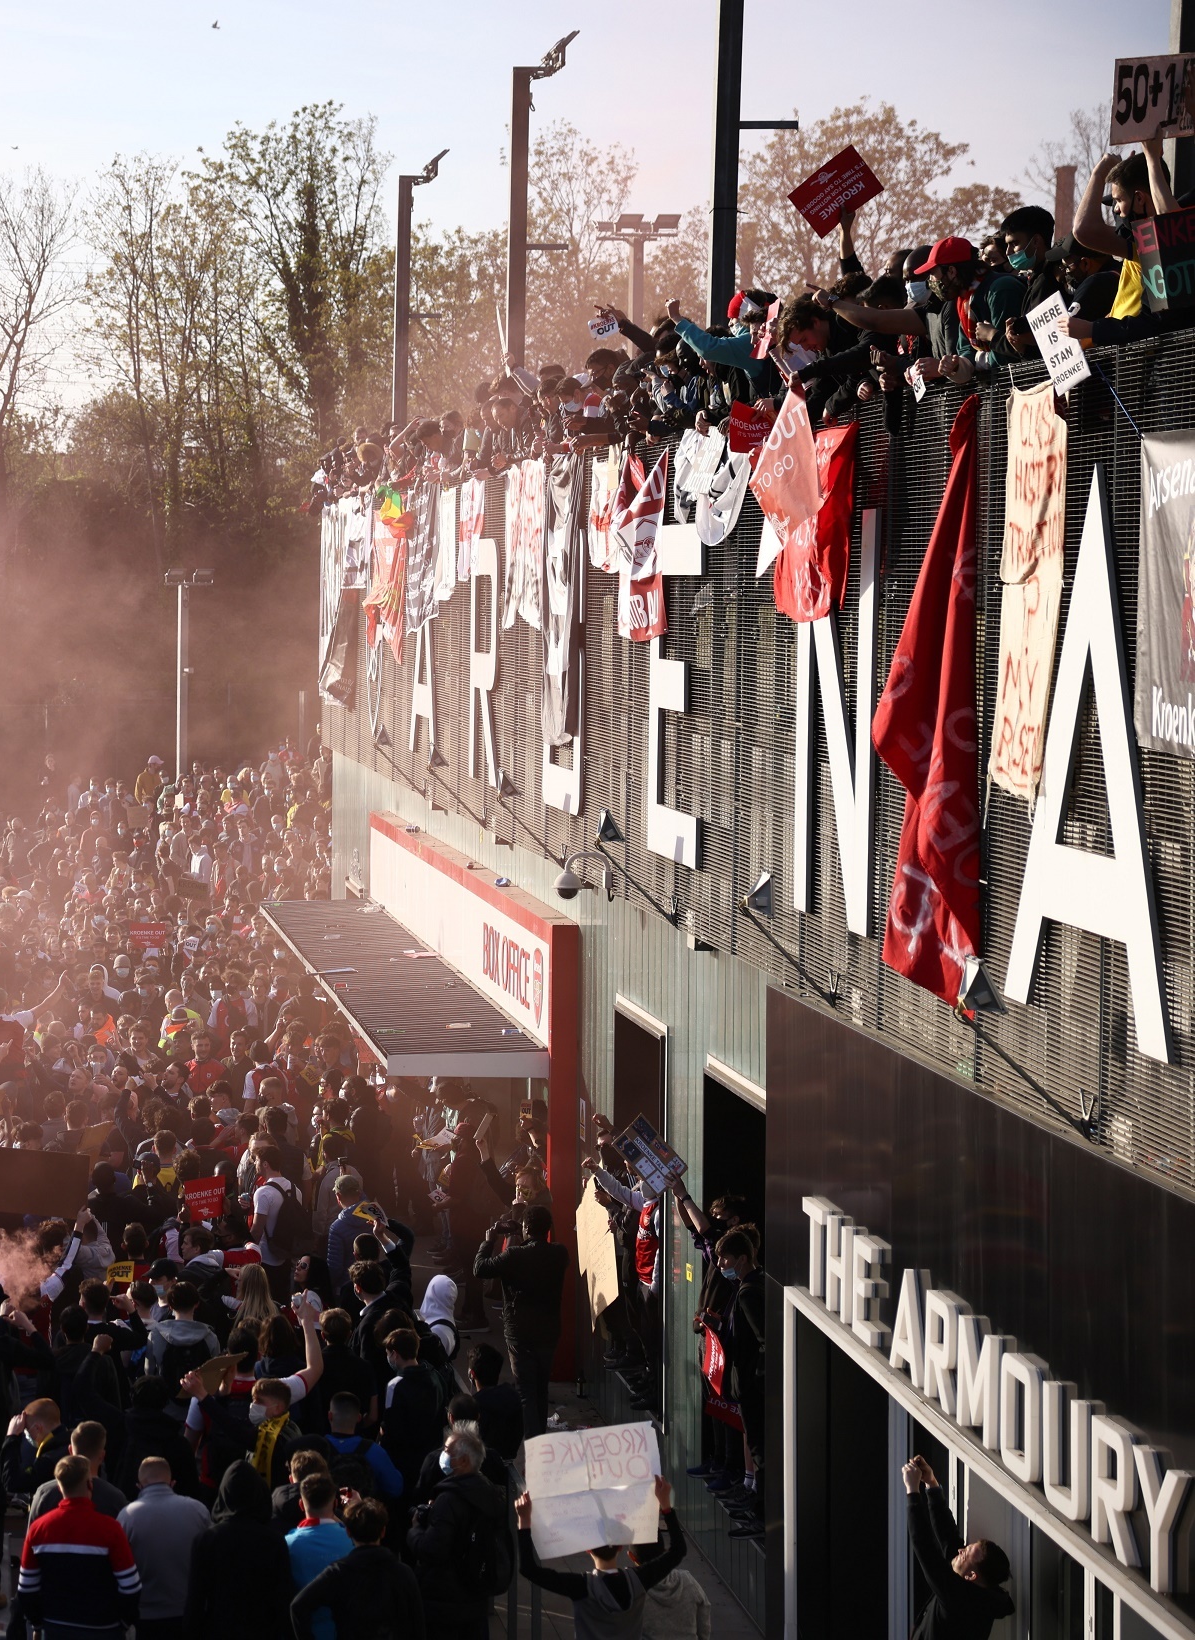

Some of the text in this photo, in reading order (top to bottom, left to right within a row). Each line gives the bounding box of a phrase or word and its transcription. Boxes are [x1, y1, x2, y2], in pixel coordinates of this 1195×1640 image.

[1115, 63, 1177, 127] 50+1
[810, 171, 864, 215] THANKS FOR NOTHING
[818, 181, 866, 221] KROENKE
[597, 322, 616, 335] OUT
[1030, 304, 1063, 332] WHERE
[1048, 331, 1059, 345] IS
[1049, 345, 1074, 369] STAN
[1053, 361, 1085, 387] KROENKE?
[730, 417, 770, 431] KROENKE
[767, 402, 808, 451] OUT
[756, 454, 794, 493] TO GO
[482, 922, 531, 1011] BOX OFFICE
[634, 1137, 657, 1163] KROENKE
[654, 1158, 665, 1171] TAX
[184, 1187, 225, 1201] KROENKE OUT
[110, 1270, 131, 1278] OUT
[708, 1397, 728, 1409] OUT
[802, 1196, 1195, 1594] THE ARMOURY
